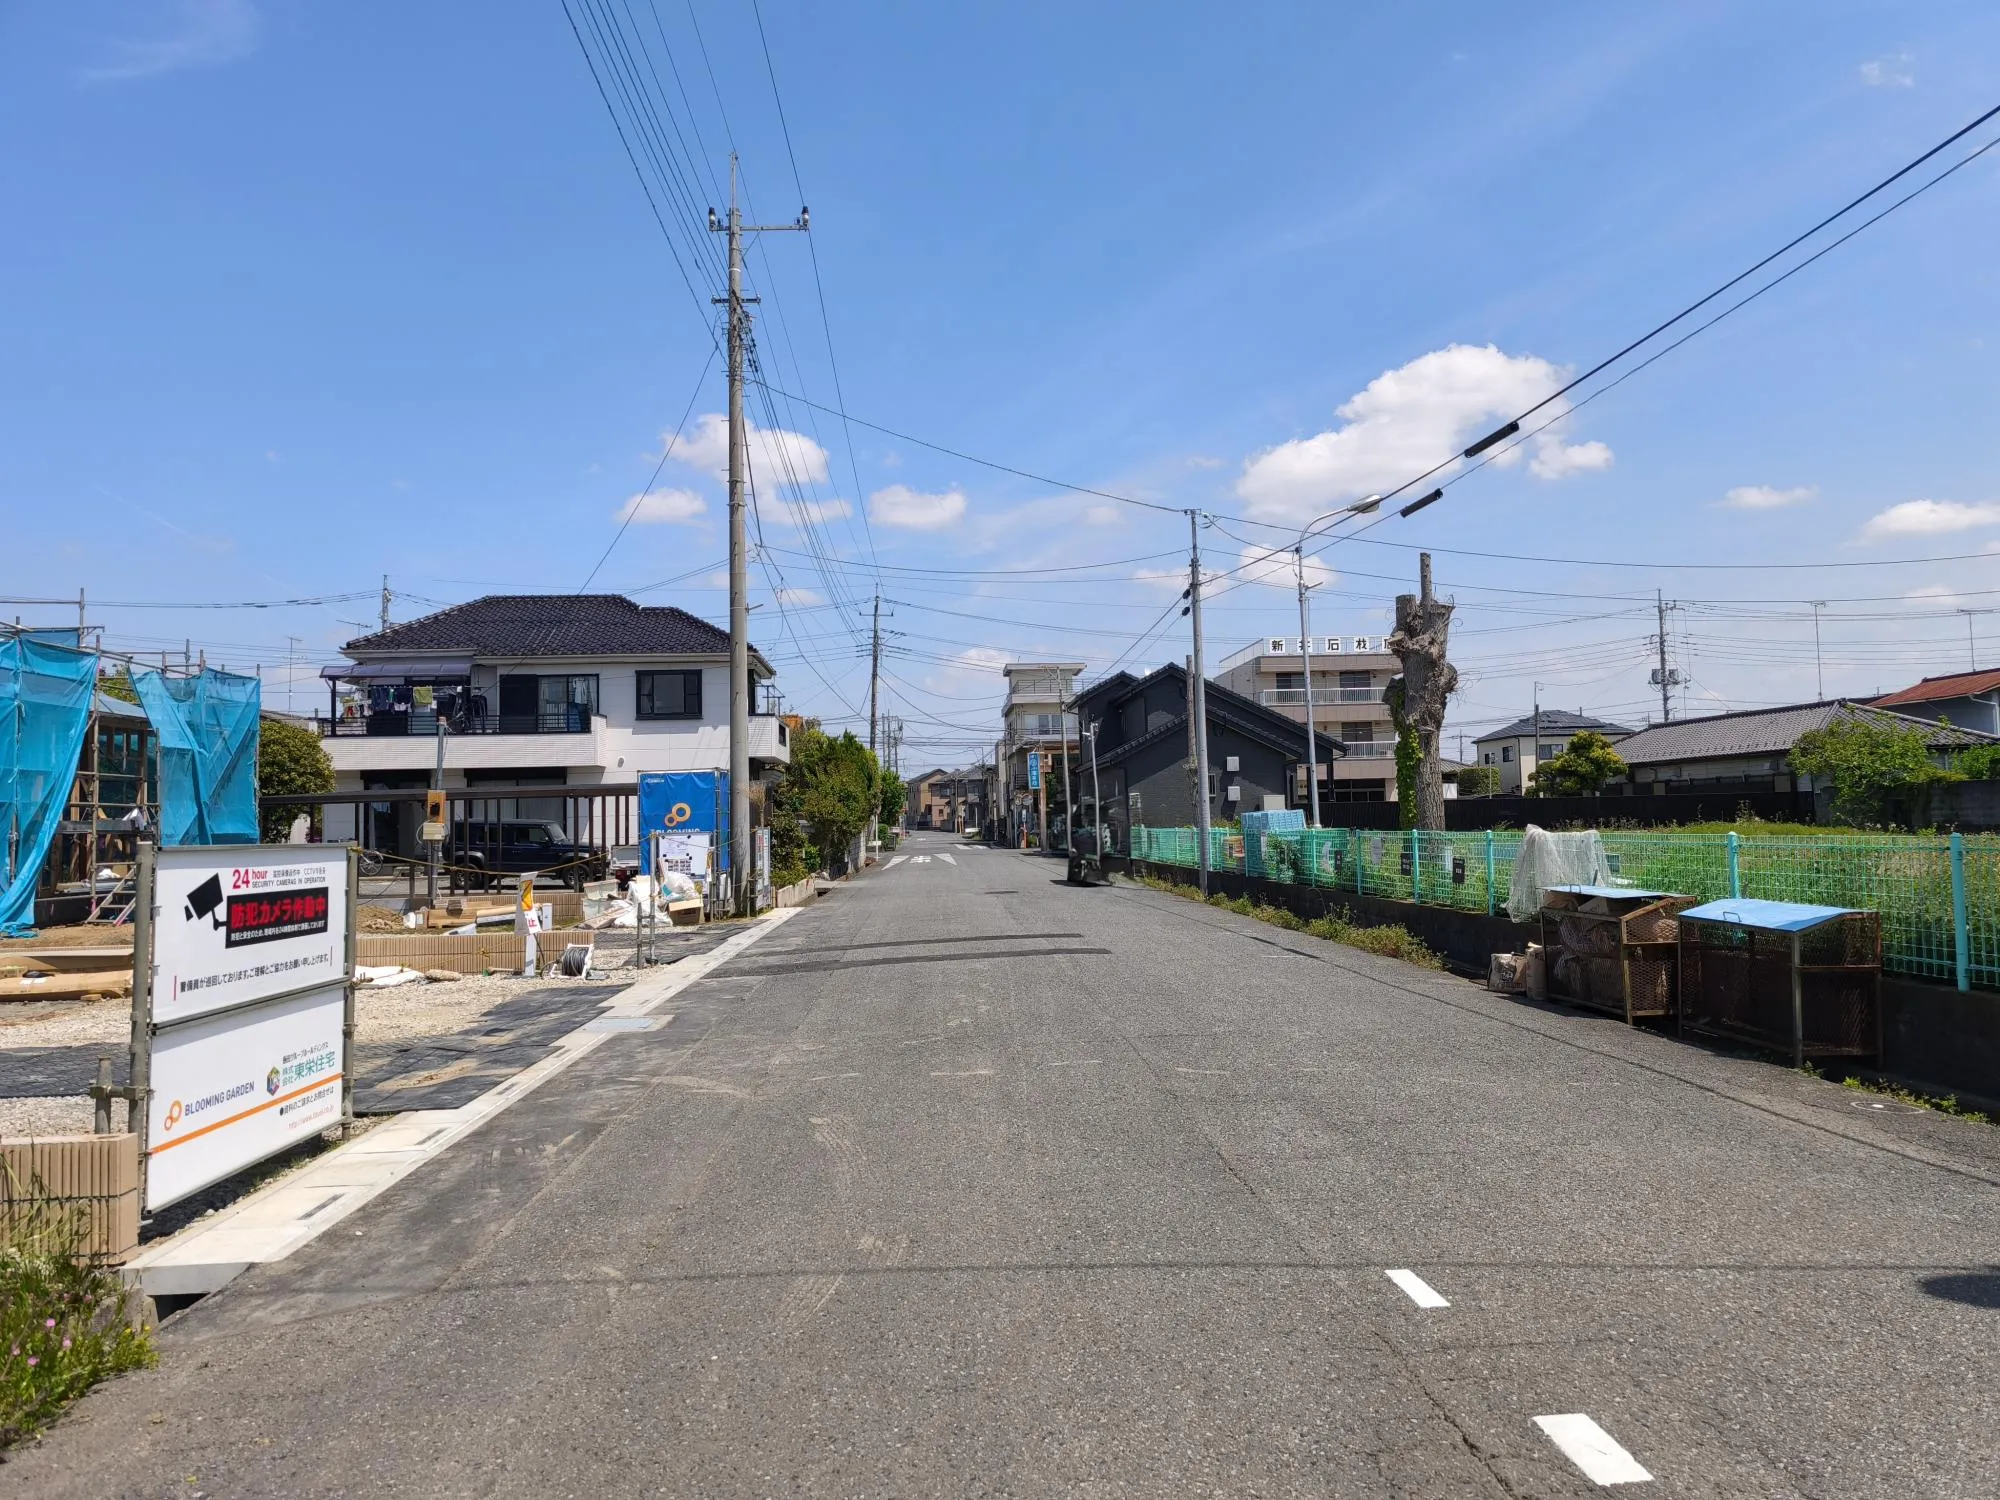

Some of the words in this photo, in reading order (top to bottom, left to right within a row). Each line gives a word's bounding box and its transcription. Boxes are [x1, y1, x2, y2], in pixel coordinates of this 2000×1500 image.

[232, 869, 250, 889] 24
[252, 869, 268, 880] hour
[252, 880, 274, 888] SECURITY
[276, 878, 296, 887] CAMERAS
[305, 876, 326, 884] OPERATION
[231, 895, 326, 928] 防犯カメラ作動中
[294, 1051, 336, 1081] 東栄住宅
[184, 1091, 225, 1116] BLOOMING
[226, 1081, 255, 1101] GARDEN
